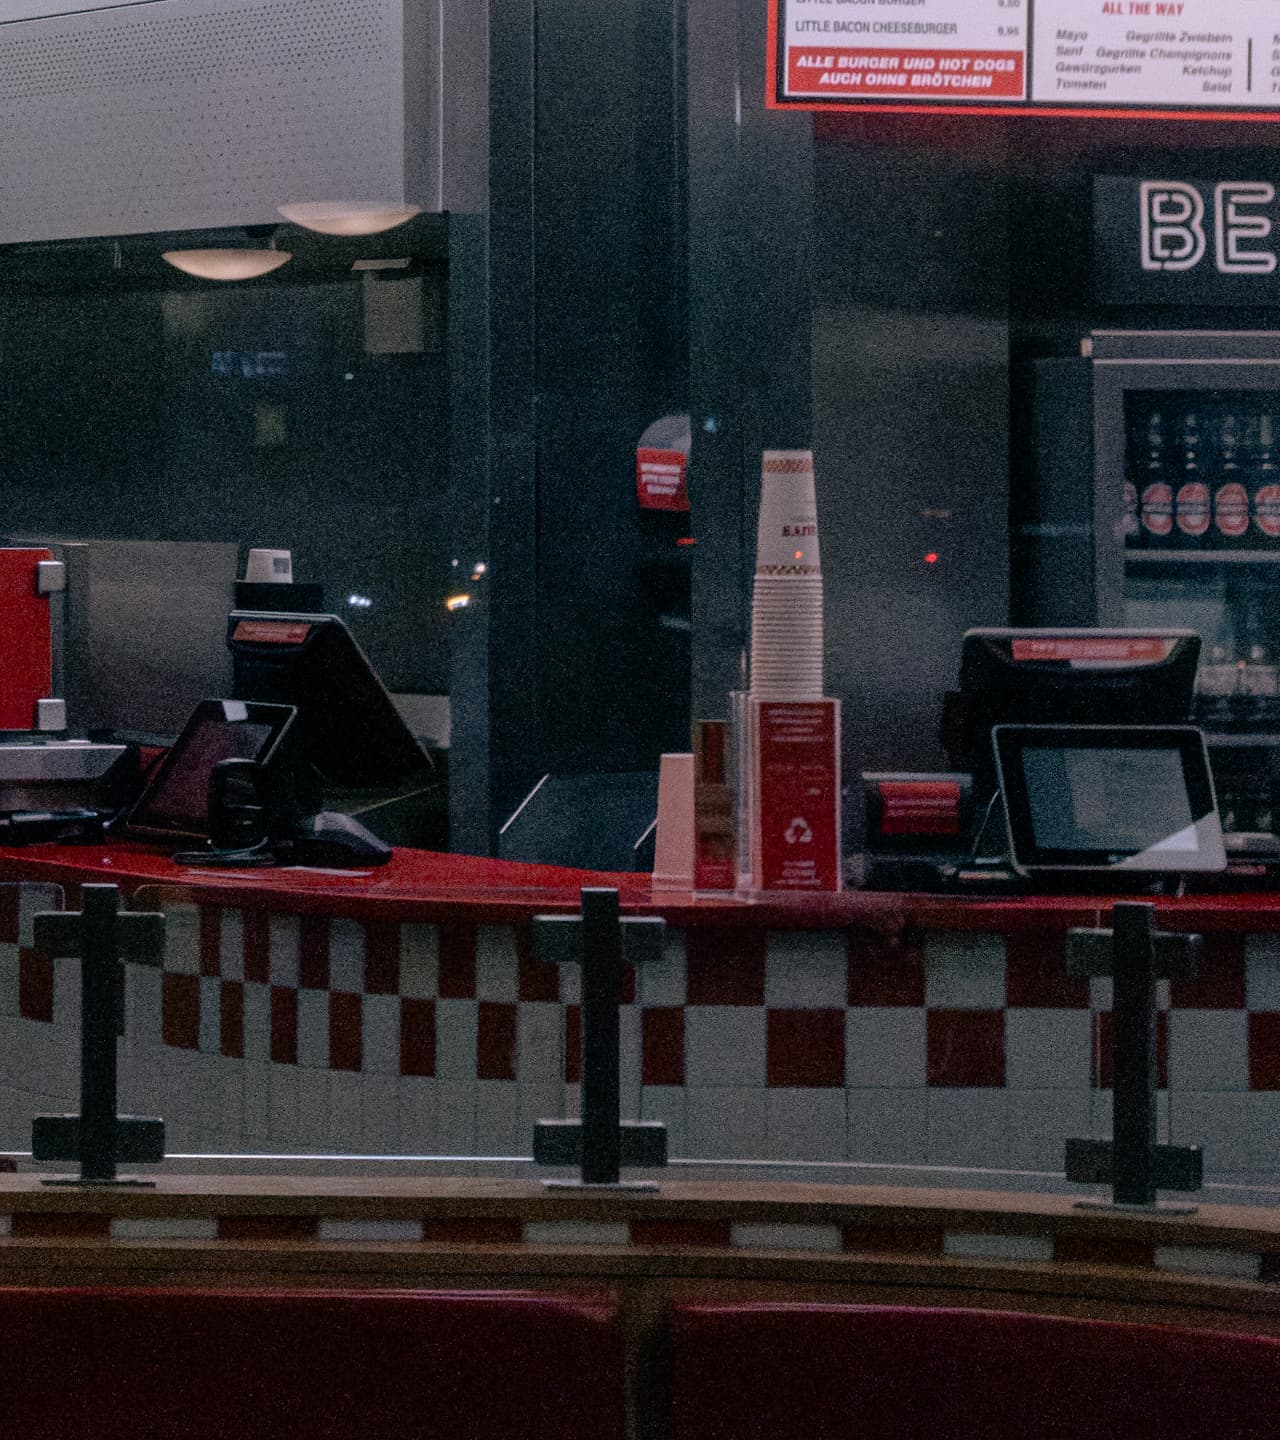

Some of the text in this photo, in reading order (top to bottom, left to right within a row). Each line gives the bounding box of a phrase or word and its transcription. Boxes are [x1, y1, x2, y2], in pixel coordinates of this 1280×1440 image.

[1155, 2, 1184, 16] WAY
[795, 19, 958, 35] LITTLE BACON CHEESEBURGER
[796, 55, 1016, 72] ALLE BURGER UND HOT DOGS
[819, 72, 993, 88] AUCH OHNE BRÖTCHEN
[1140, 181, 1280, 274] BE
